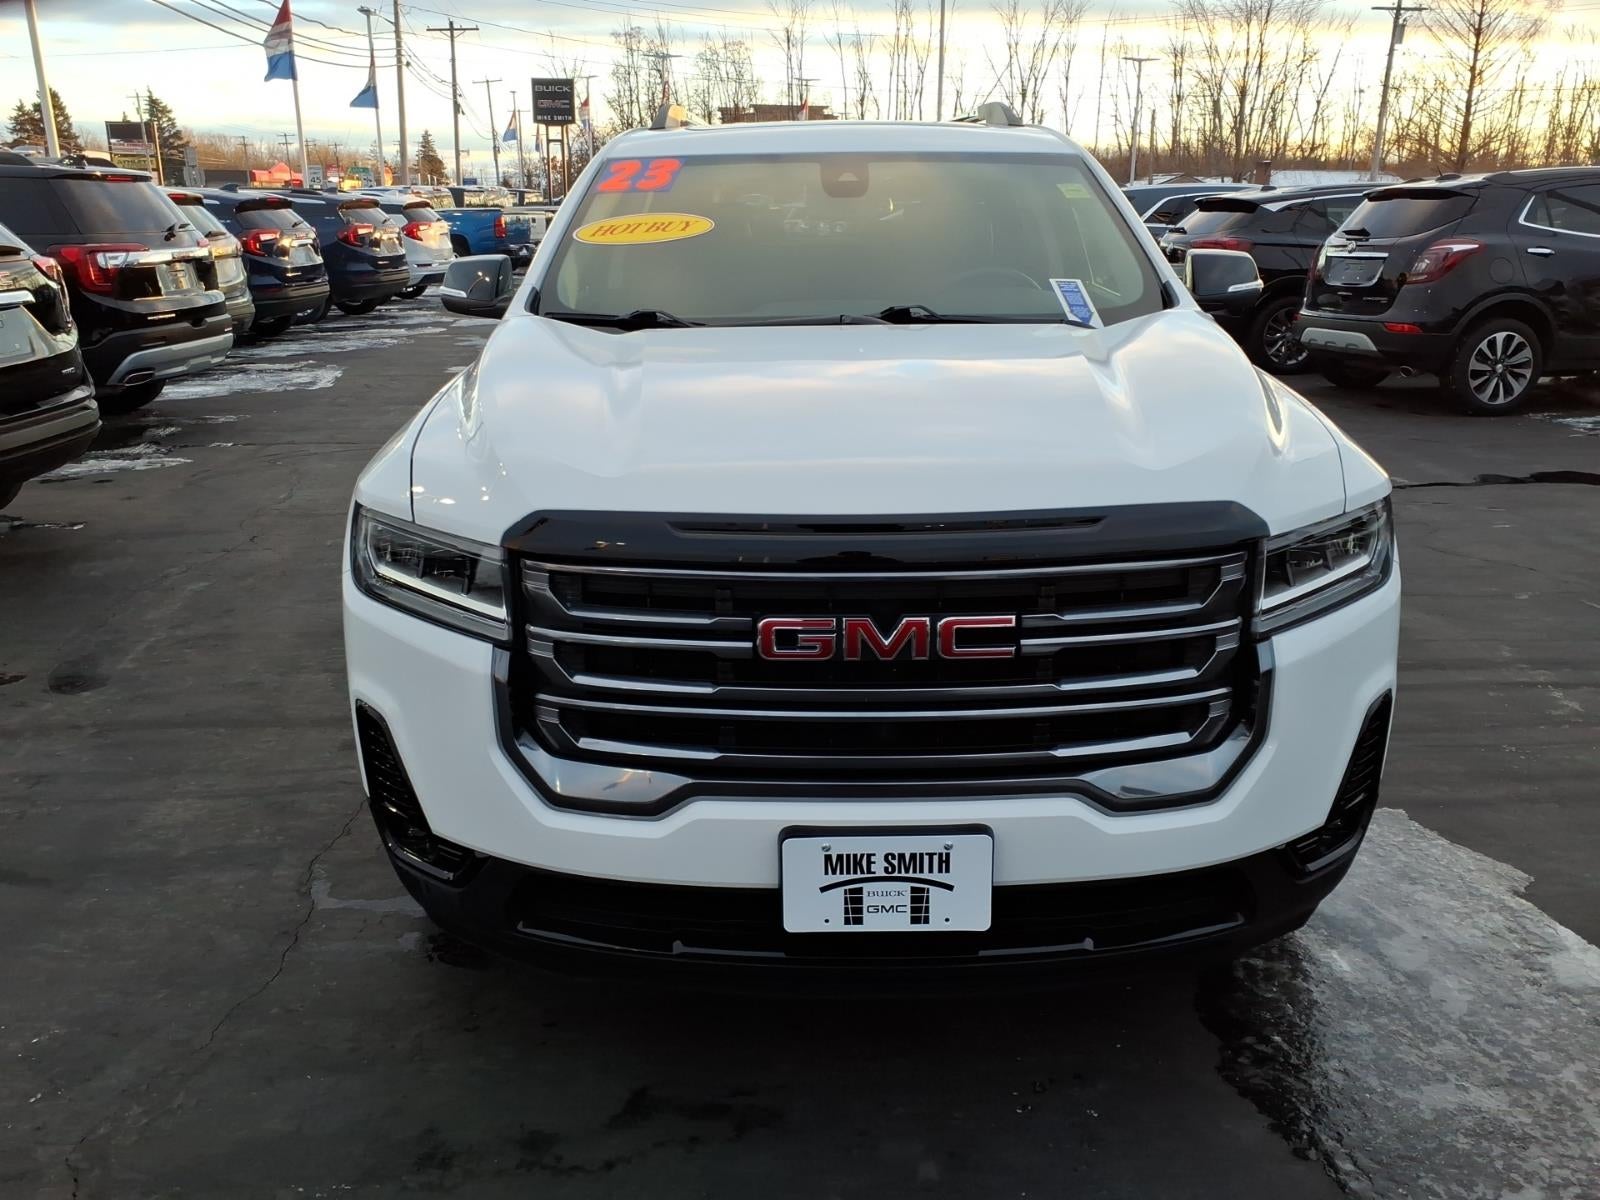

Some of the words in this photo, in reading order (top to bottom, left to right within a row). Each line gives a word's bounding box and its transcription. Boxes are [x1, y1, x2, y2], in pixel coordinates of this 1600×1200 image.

[537, 99, 570, 108] GMC
[597, 158, 683, 192] 23
[589, 222, 648, 238] HOT
[643, 220, 699, 234] BUY
[757, 615, 1017, 660] GMC
[823, 853, 876, 875] MIKE
[883, 852, 951, 875] SMITH
[867, 890, 907, 898] BUICK
[866, 904, 908, 914] GMC
